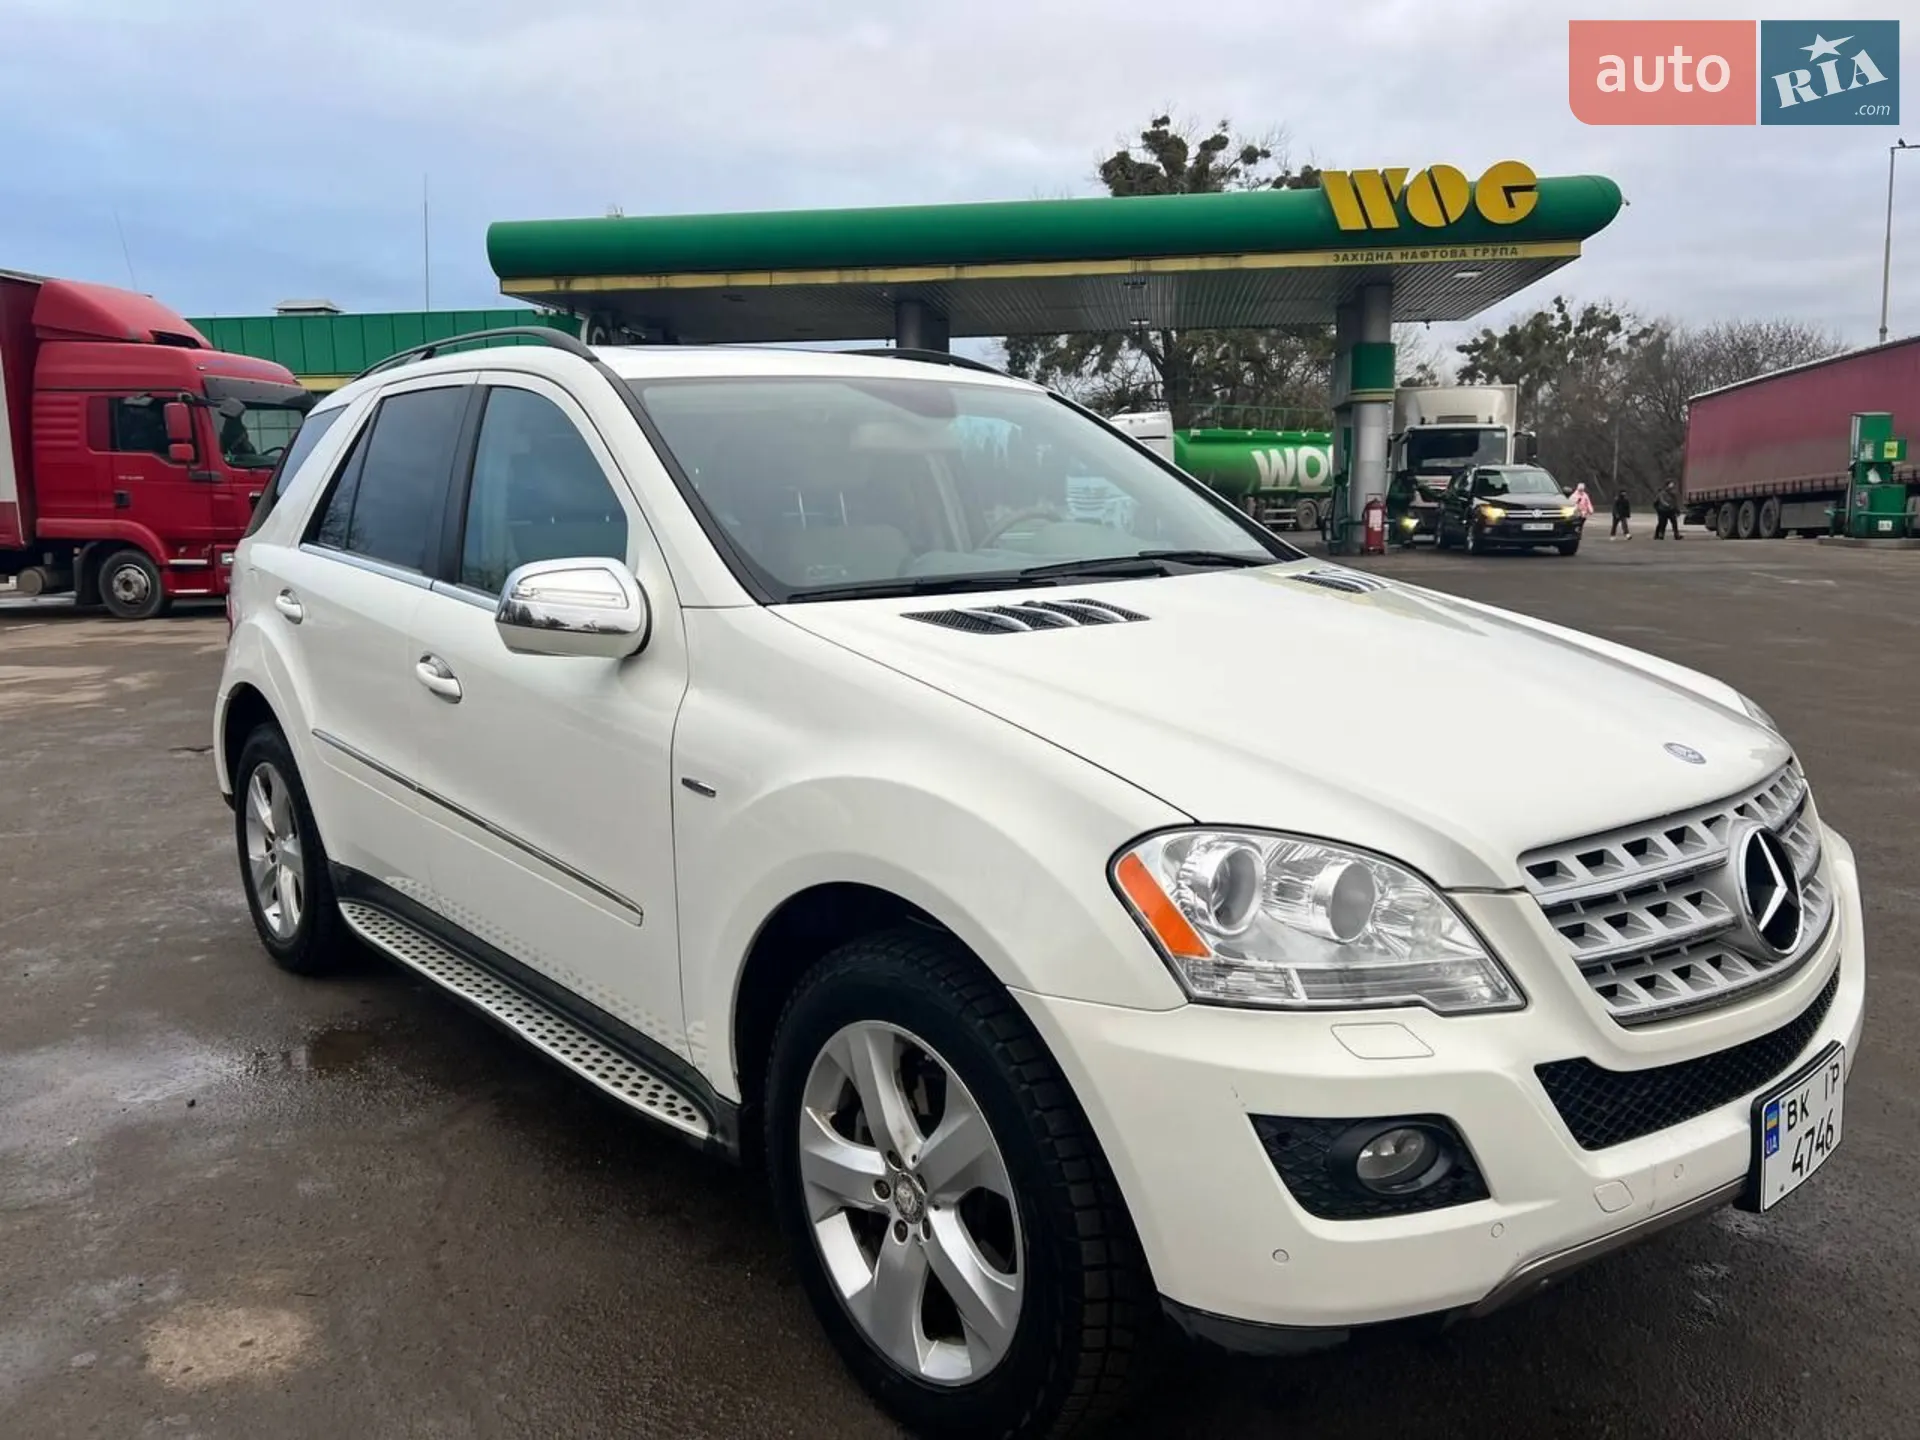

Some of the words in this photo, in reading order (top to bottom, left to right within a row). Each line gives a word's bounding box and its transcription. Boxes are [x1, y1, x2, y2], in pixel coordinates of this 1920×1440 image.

[1320, 160, 1538, 230] WOG
[1332, 251, 1394, 263] ЗАХІДНА
[1400, 247, 1468, 260] НАФТОВА
[1473, 245, 1518, 257] ГРУПА
[1251, 444, 1334, 489] WO
[1765, 1134, 1778, 1155] UA
[1791, 1108, 1834, 1177] 4746
